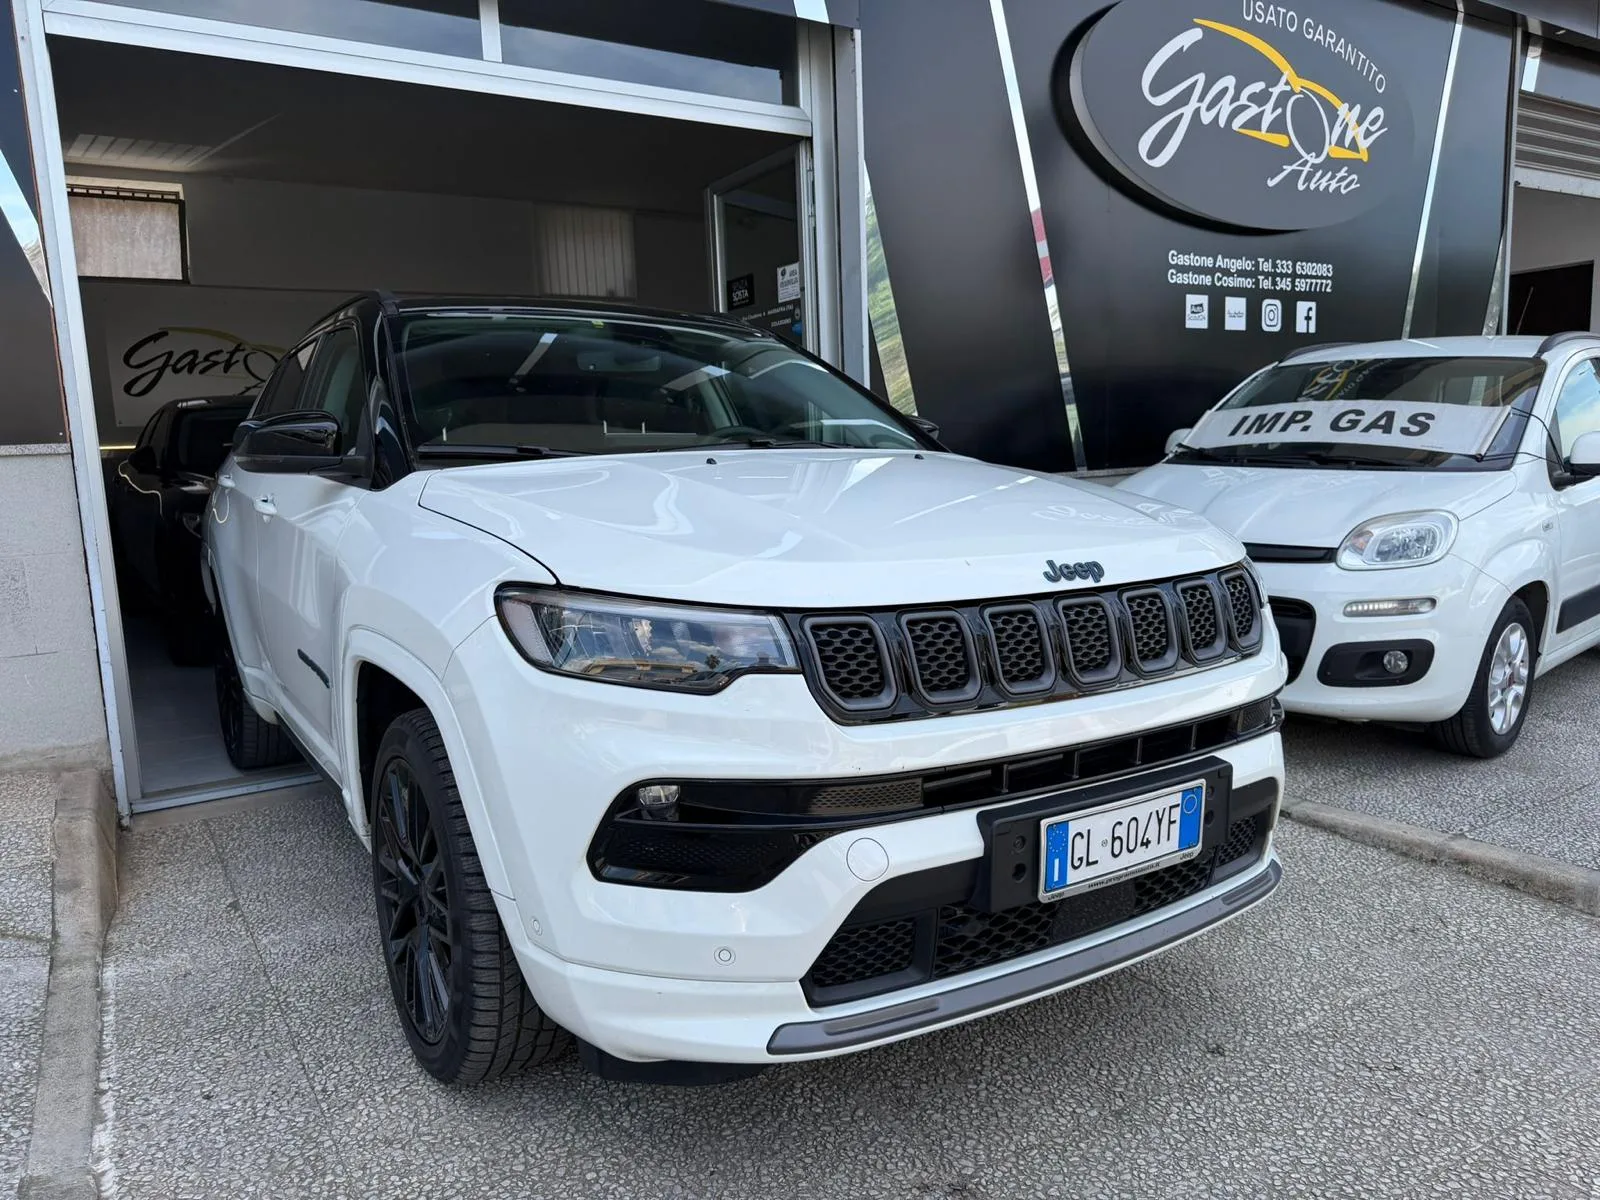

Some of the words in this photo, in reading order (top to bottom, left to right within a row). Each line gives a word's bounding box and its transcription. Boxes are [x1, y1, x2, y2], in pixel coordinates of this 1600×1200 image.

[1243, 0, 1298, 32] USATO
[1303, 17, 1387, 94] GARANTITO
[1267, 153, 1361, 195] Auto
[1168, 250, 1213, 268] Gastone
[1215, 254, 1256, 273] Angelo:
[1258, 258, 1274, 273] Tel.
[1275, 260, 1293, 274] 333
[1295, 261, 1333, 277] 6302083
[1167, 269, 1212, 285] Gastone
[1214, 272, 1256, 288] Cosimo:
[1258, 275, 1274, 290] Tel.
[1275, 278, 1292, 291] 345
[1295, 278, 1332, 293] 5977772
[1228, 409, 1314, 438] IMP.
[1329, 408, 1435, 438] GAS
[1042, 559, 1105, 583] Jeep
[1070, 828, 1099, 870] GL
[1111, 803, 1181, 859] 604YF
